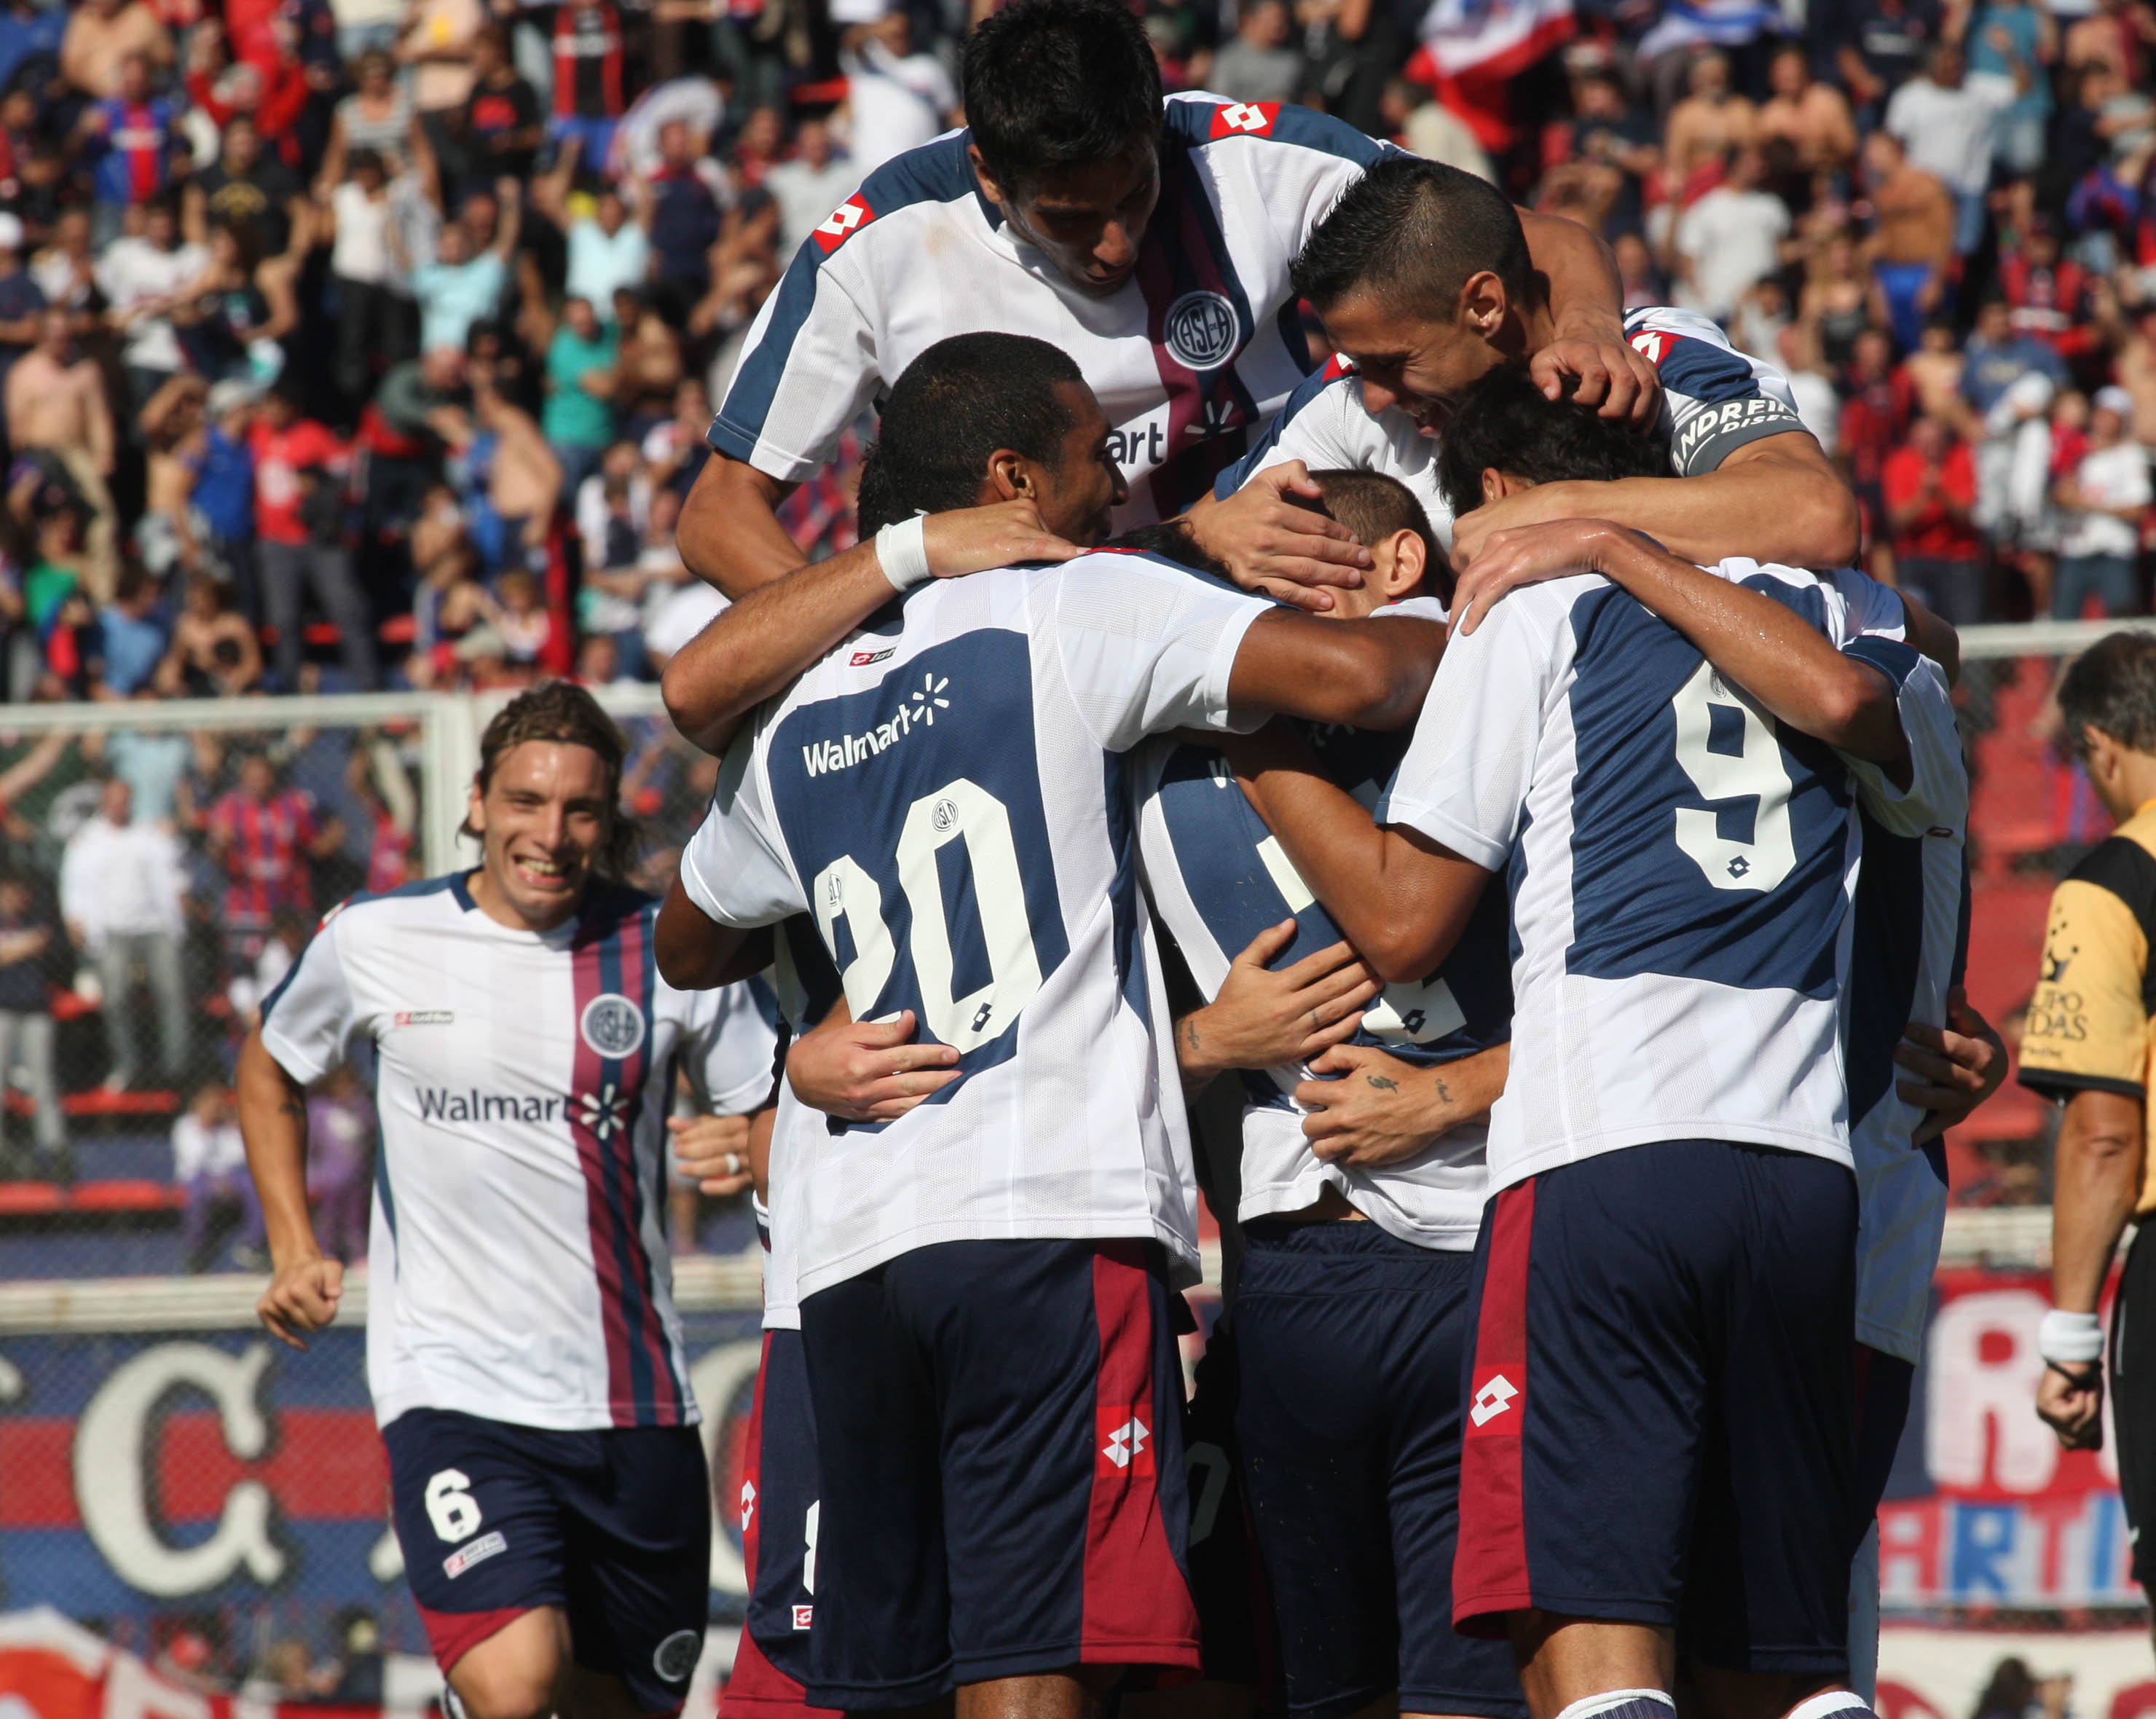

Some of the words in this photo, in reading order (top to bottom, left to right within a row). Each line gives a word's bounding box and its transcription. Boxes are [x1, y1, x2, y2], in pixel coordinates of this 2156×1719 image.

[803, 704, 910, 777] Walmart
[1672, 659, 1796, 893] 9
[814, 777, 1043, 1055] 20
[414, 1087, 577, 1122] Walmart
[425, 1468, 482, 1543] 6
